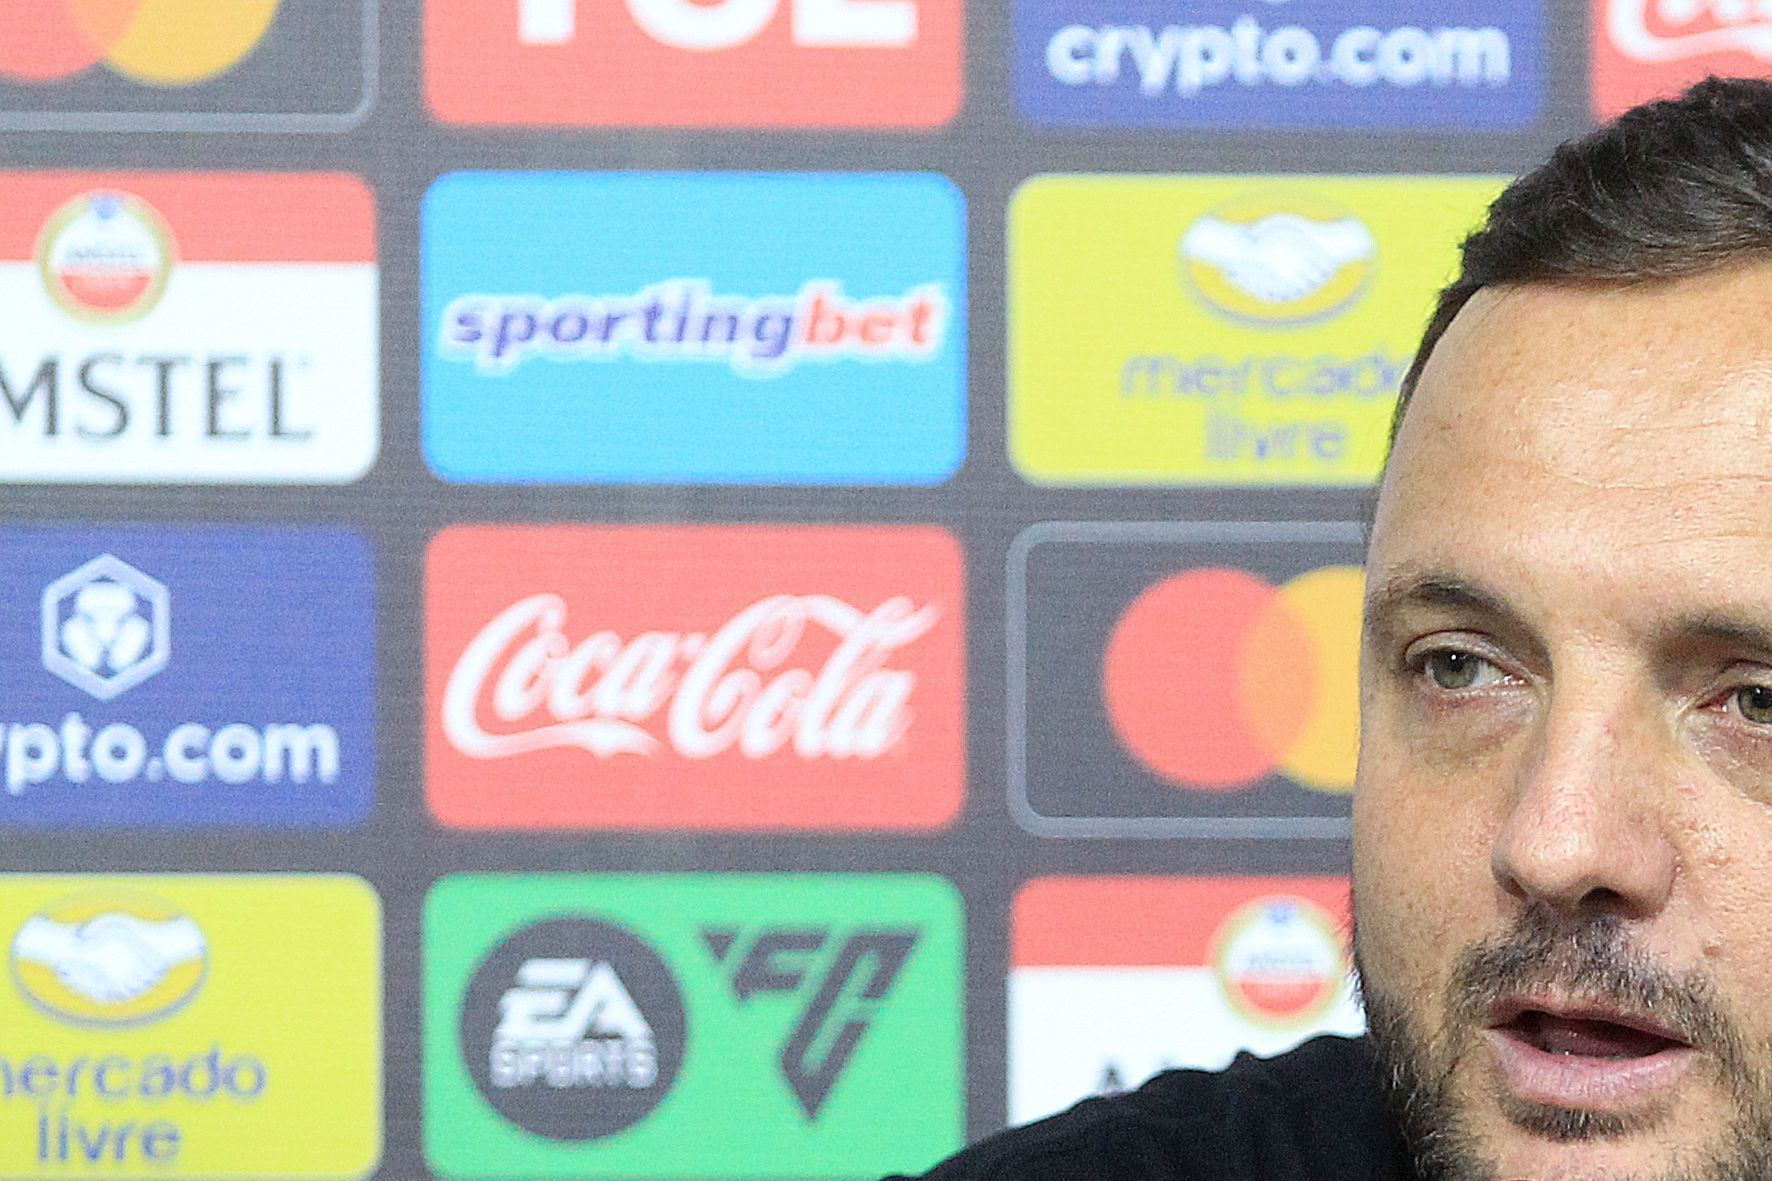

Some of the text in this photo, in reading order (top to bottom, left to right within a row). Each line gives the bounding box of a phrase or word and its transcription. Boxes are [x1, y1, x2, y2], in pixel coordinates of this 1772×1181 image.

[1045, 14, 1511, 98] crypto.com
[446, 284, 943, 370] sportingbet
[442, 593, 940, 758] Coca-Cola
[0, 712, 341, 796] pto.com
[500, 957, 652, 1040] EA
[0, 1043, 267, 1102] ercado
[36, 1108, 181, 1166] livre
